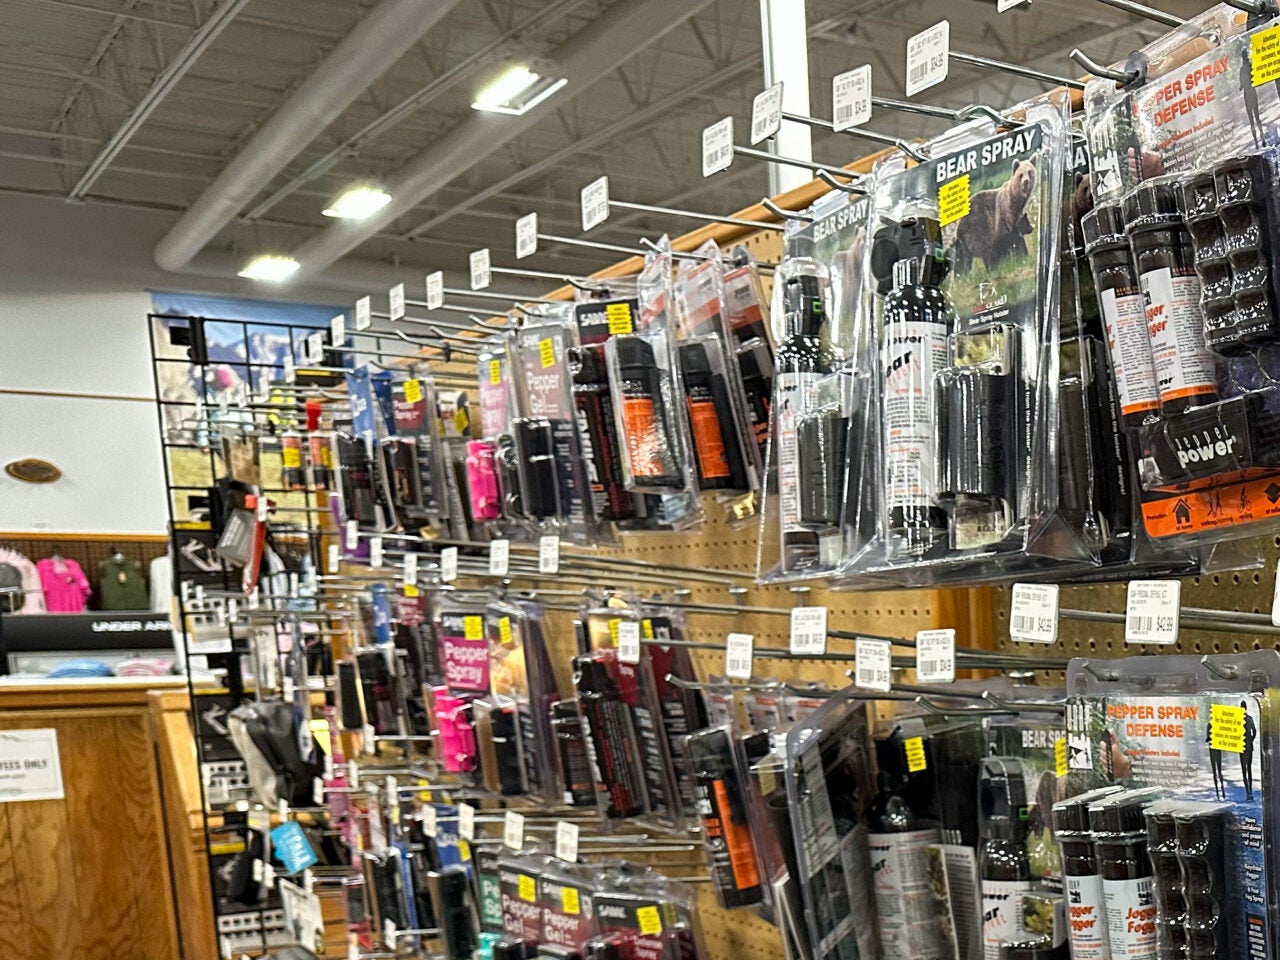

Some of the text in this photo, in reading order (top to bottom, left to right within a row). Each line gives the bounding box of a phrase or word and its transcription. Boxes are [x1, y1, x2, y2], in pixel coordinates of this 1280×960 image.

[1185, 55, 1231, 92] SPRAY
[1154, 85, 1215, 126] DEFENSE
[936, 129, 1038, 183] BEAR SPRAY
[813, 219, 836, 243] BEAR
[92, 621, 142, 632] UNDER
[444, 642, 488, 663] Pepper
[447, 664, 482, 684] Spray
[1107, 704, 1199, 722] PEPPER SPRAY
[1021, 729, 1046, 749] BEAR
[1126, 723, 1184, 738] DEFENSE
